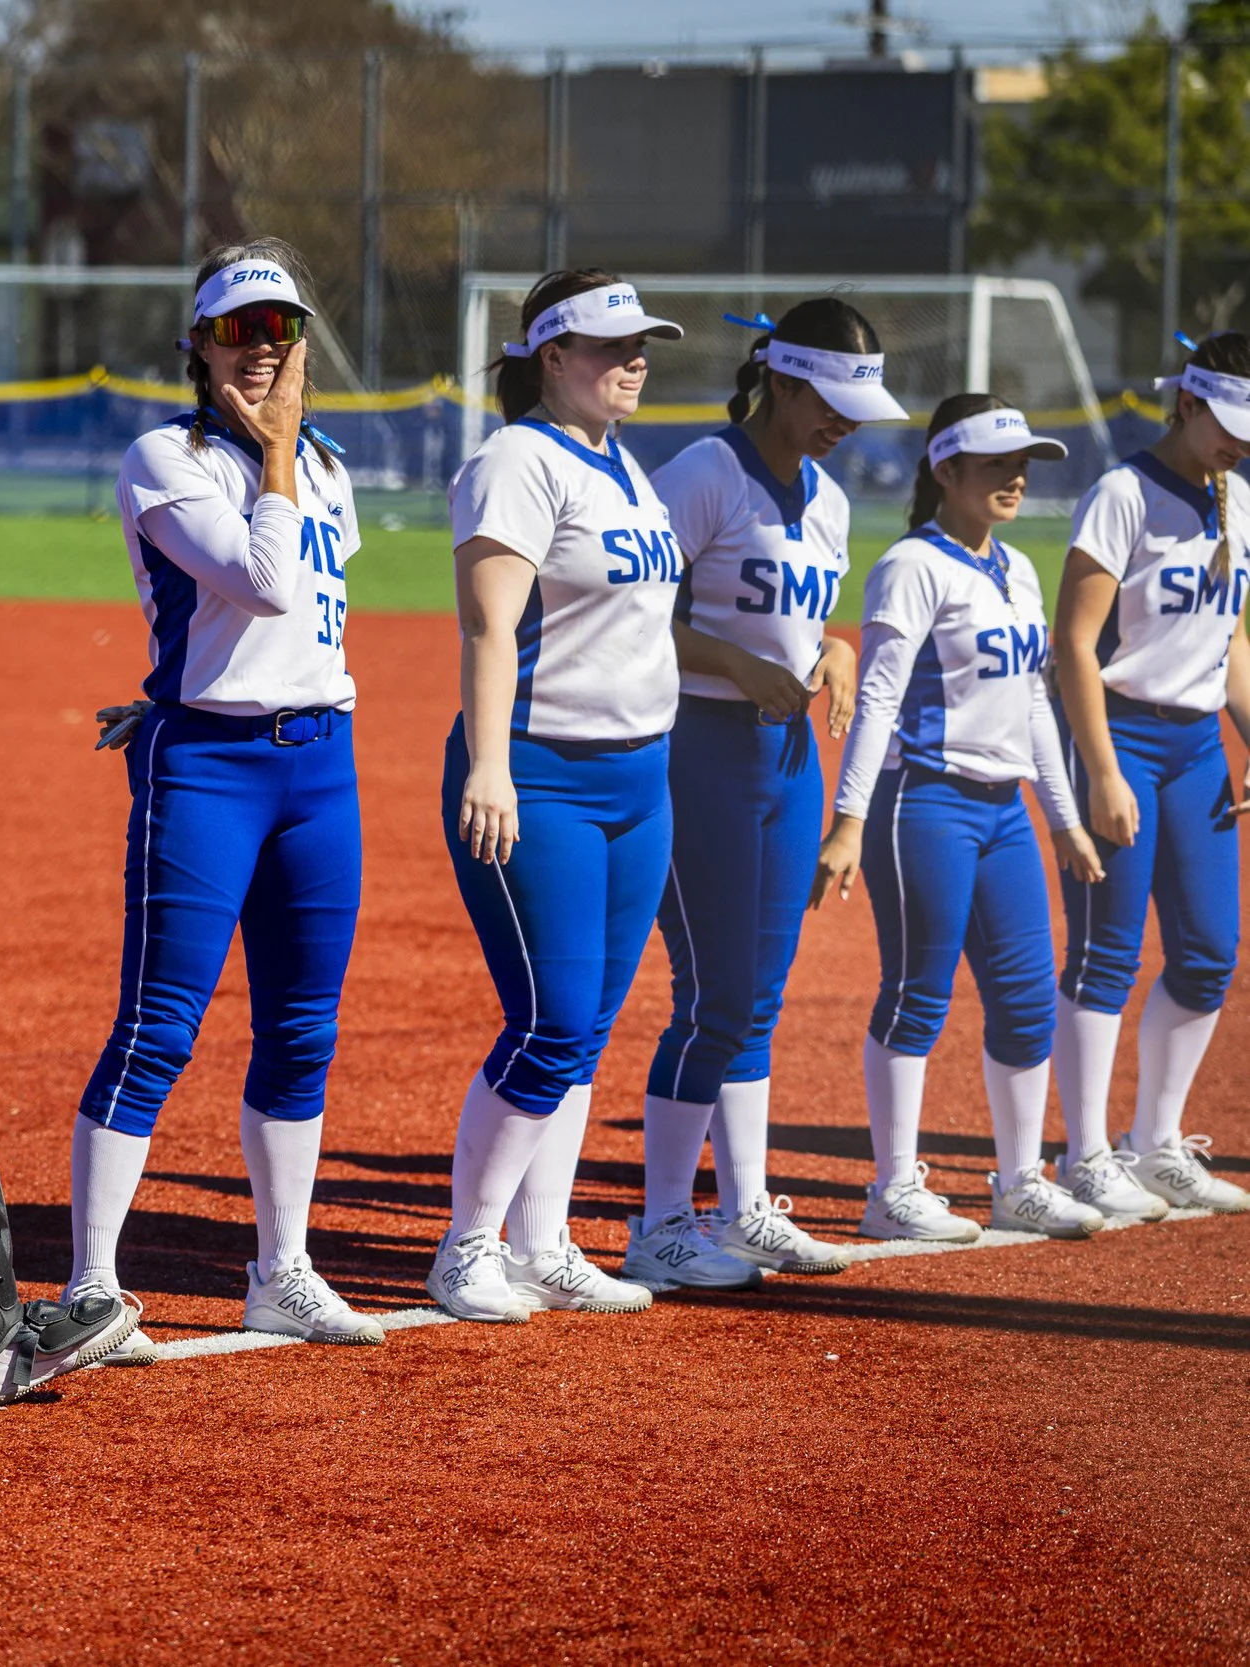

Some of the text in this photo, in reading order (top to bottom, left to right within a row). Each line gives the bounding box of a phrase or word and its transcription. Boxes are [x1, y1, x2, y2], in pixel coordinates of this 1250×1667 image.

[230, 269, 282, 287] SMC
[316, 592, 347, 651] 35
[975, 623, 1049, 680] SM
